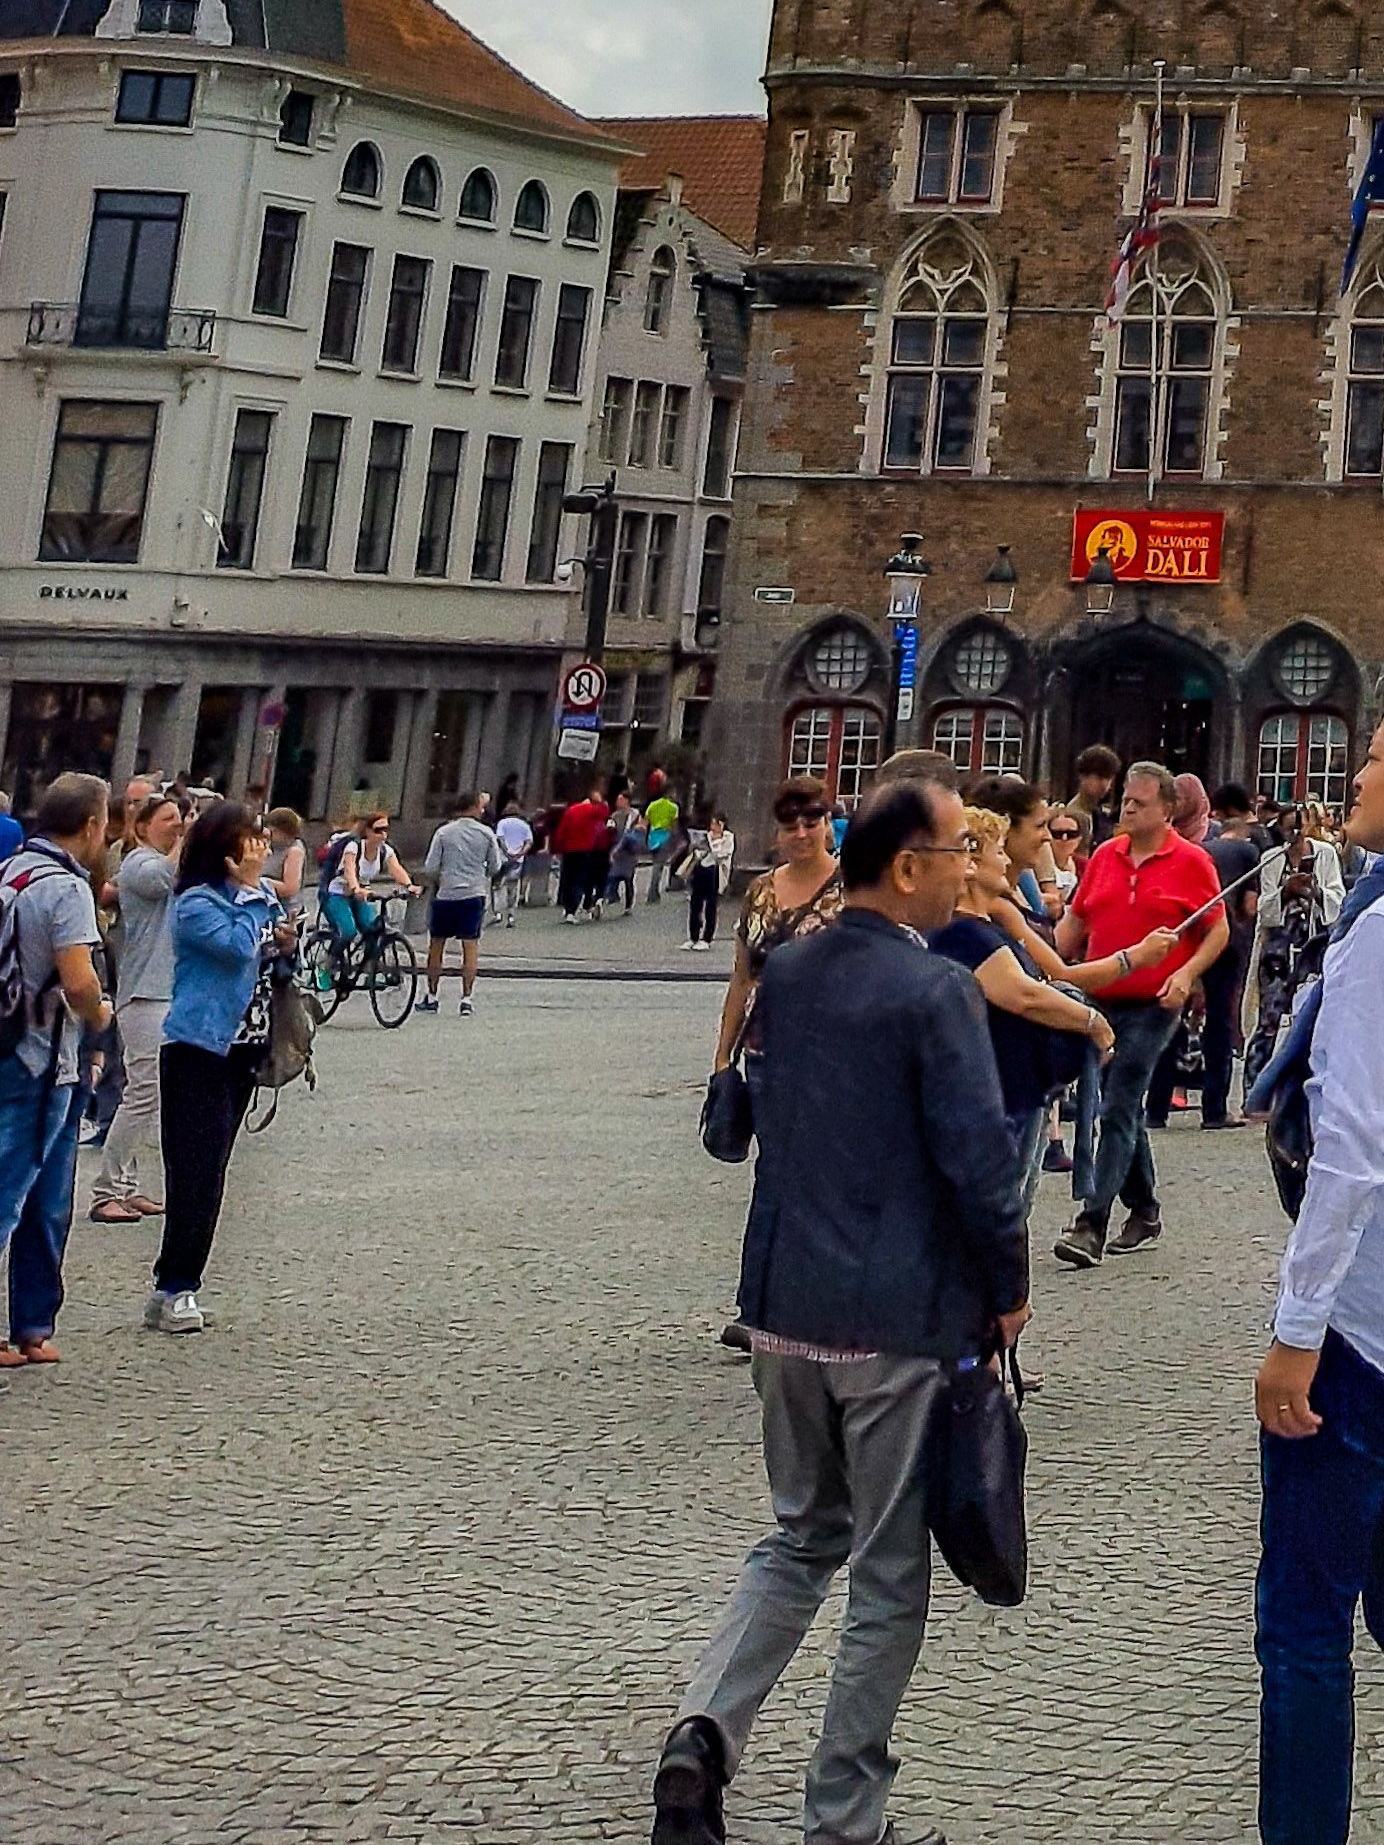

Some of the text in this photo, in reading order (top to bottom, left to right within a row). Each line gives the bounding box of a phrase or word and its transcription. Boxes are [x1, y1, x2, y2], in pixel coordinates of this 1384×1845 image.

[1148, 535, 1210, 549] SALVADOR
[1144, 548, 1209, 577] DALI
[40, 585, 128, 600] DELVAUX
